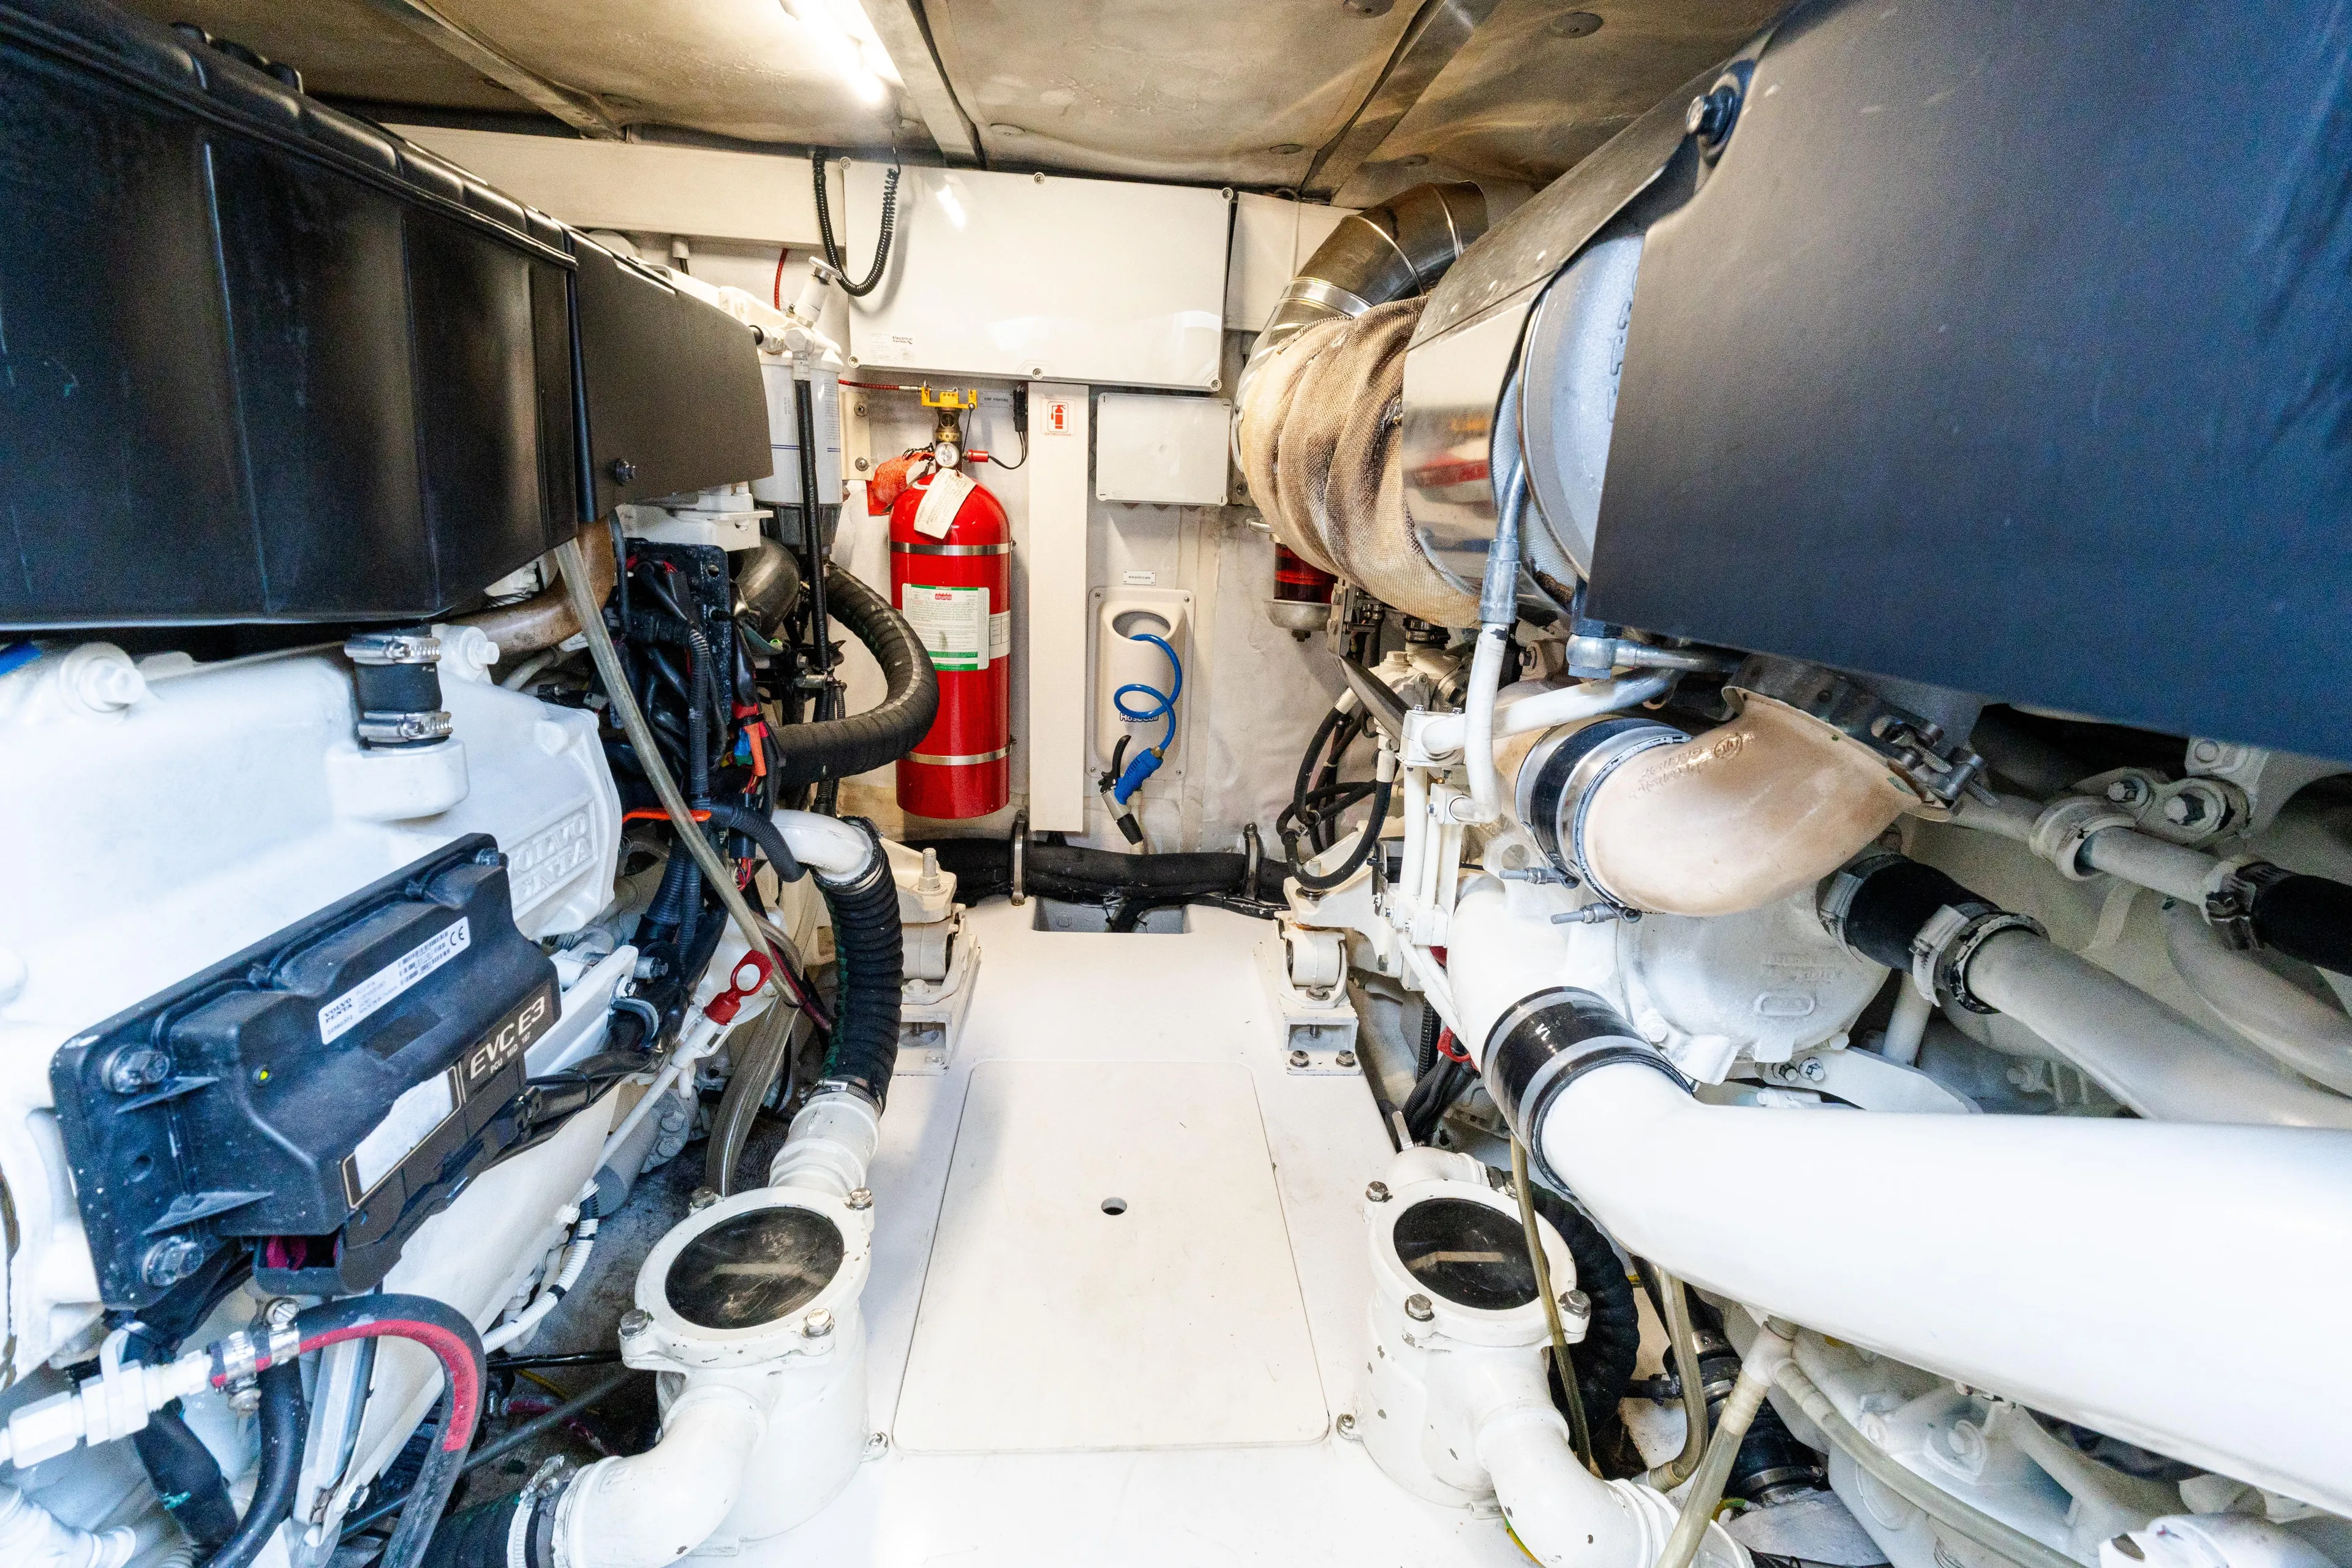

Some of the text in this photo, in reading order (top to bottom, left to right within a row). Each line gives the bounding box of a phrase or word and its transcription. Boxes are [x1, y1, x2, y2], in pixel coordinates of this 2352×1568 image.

[511, 812, 591, 873] OLVO
[512, 837, 594, 907] ENTA
[450, 925, 465, 946] CE
[324, 997, 352, 1017] VOLVO
[325, 1003, 353, 1023] PENTA
[470, 995, 545, 1080] EVC E3
[490, 1057, 503, 1074] PCU
[507, 1043, 519, 1058] MID
